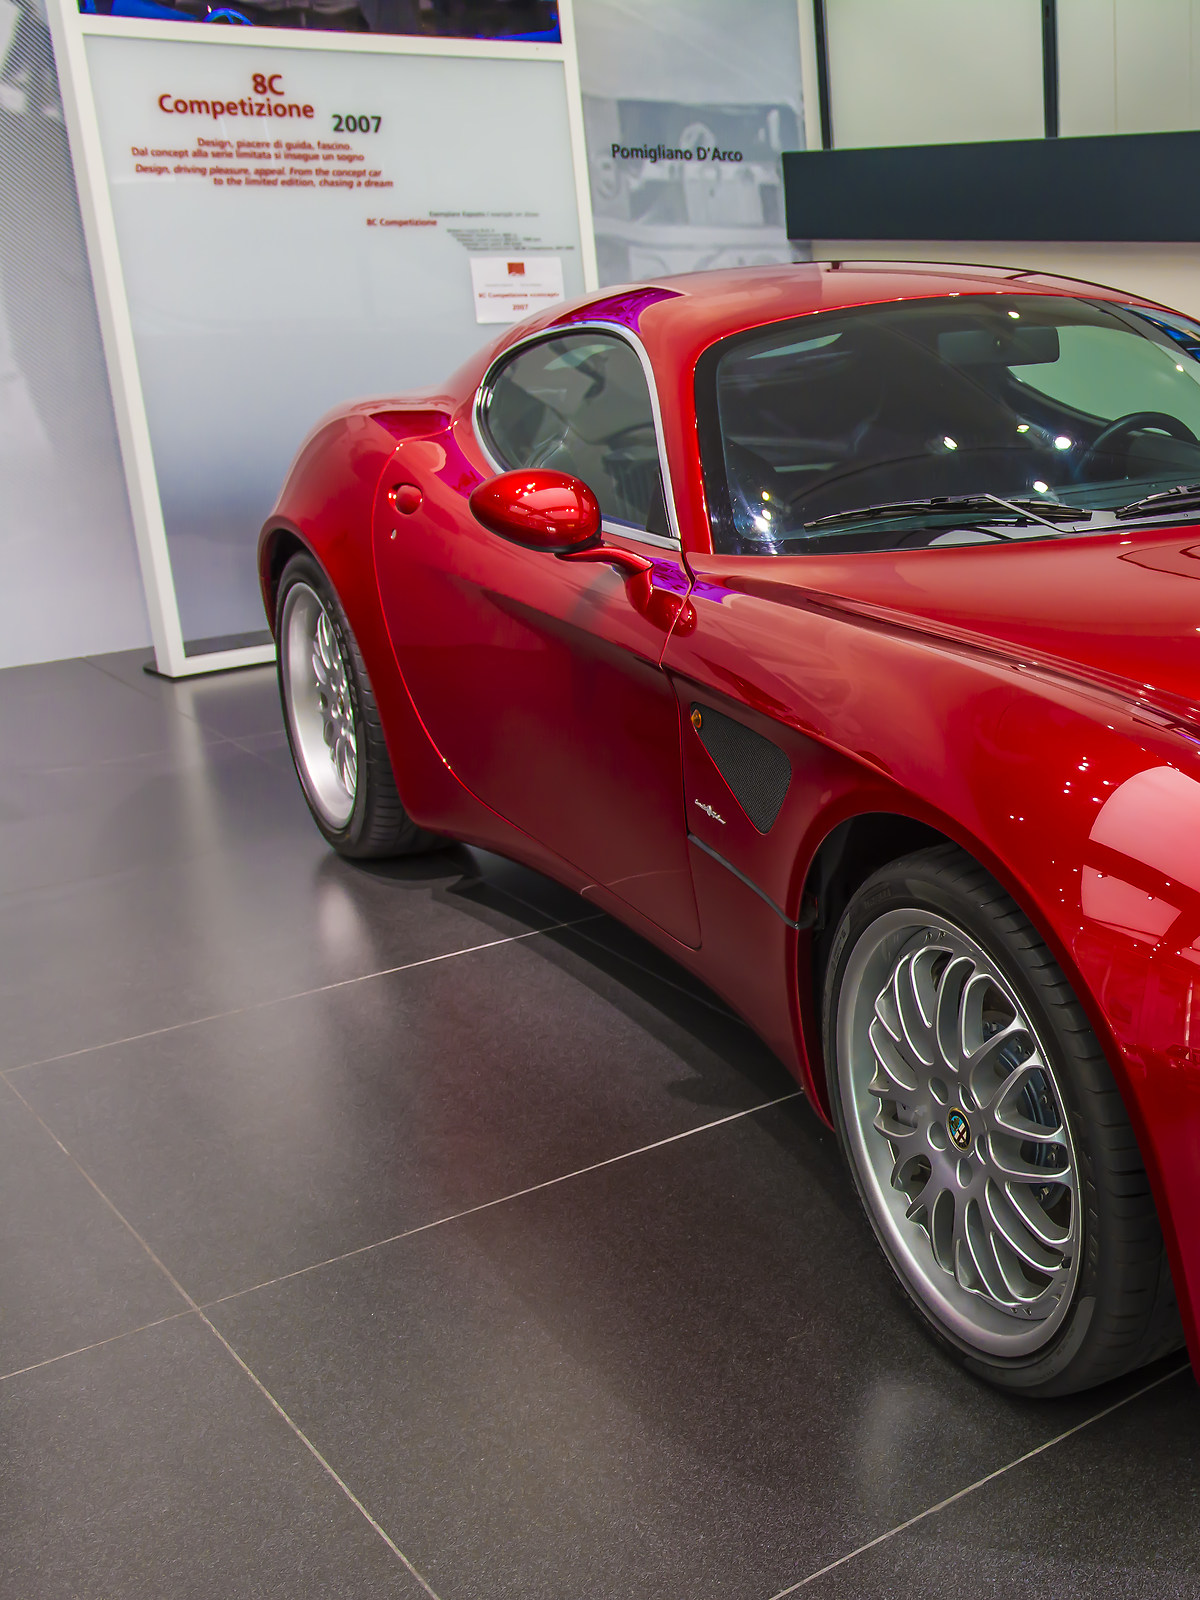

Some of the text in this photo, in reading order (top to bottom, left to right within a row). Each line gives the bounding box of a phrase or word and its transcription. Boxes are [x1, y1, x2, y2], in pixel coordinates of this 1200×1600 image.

[251, 73, 285, 96] 8C
[157, 93, 315, 120] Competizione
[331, 113, 382, 133] 2007
[236, 140, 270, 149] piacere
[273, 139, 283, 149] di
[131, 146, 365, 163] Dal concept alla serie limitata si insegue un sogno
[612, 143, 743, 164] Pomigliano D'Arco
[173, 164, 207, 176] driving
[315, 167, 330, 176] the
[331, 169, 367, 178] concept
[213, 177, 224, 185] to
[226, 177, 242, 185] the
[244, 177, 278, 187] limited
[318, 179, 354, 190] chasing
[364, 180, 394, 188] dream
[366, 218, 437, 228] 8C Competizione
